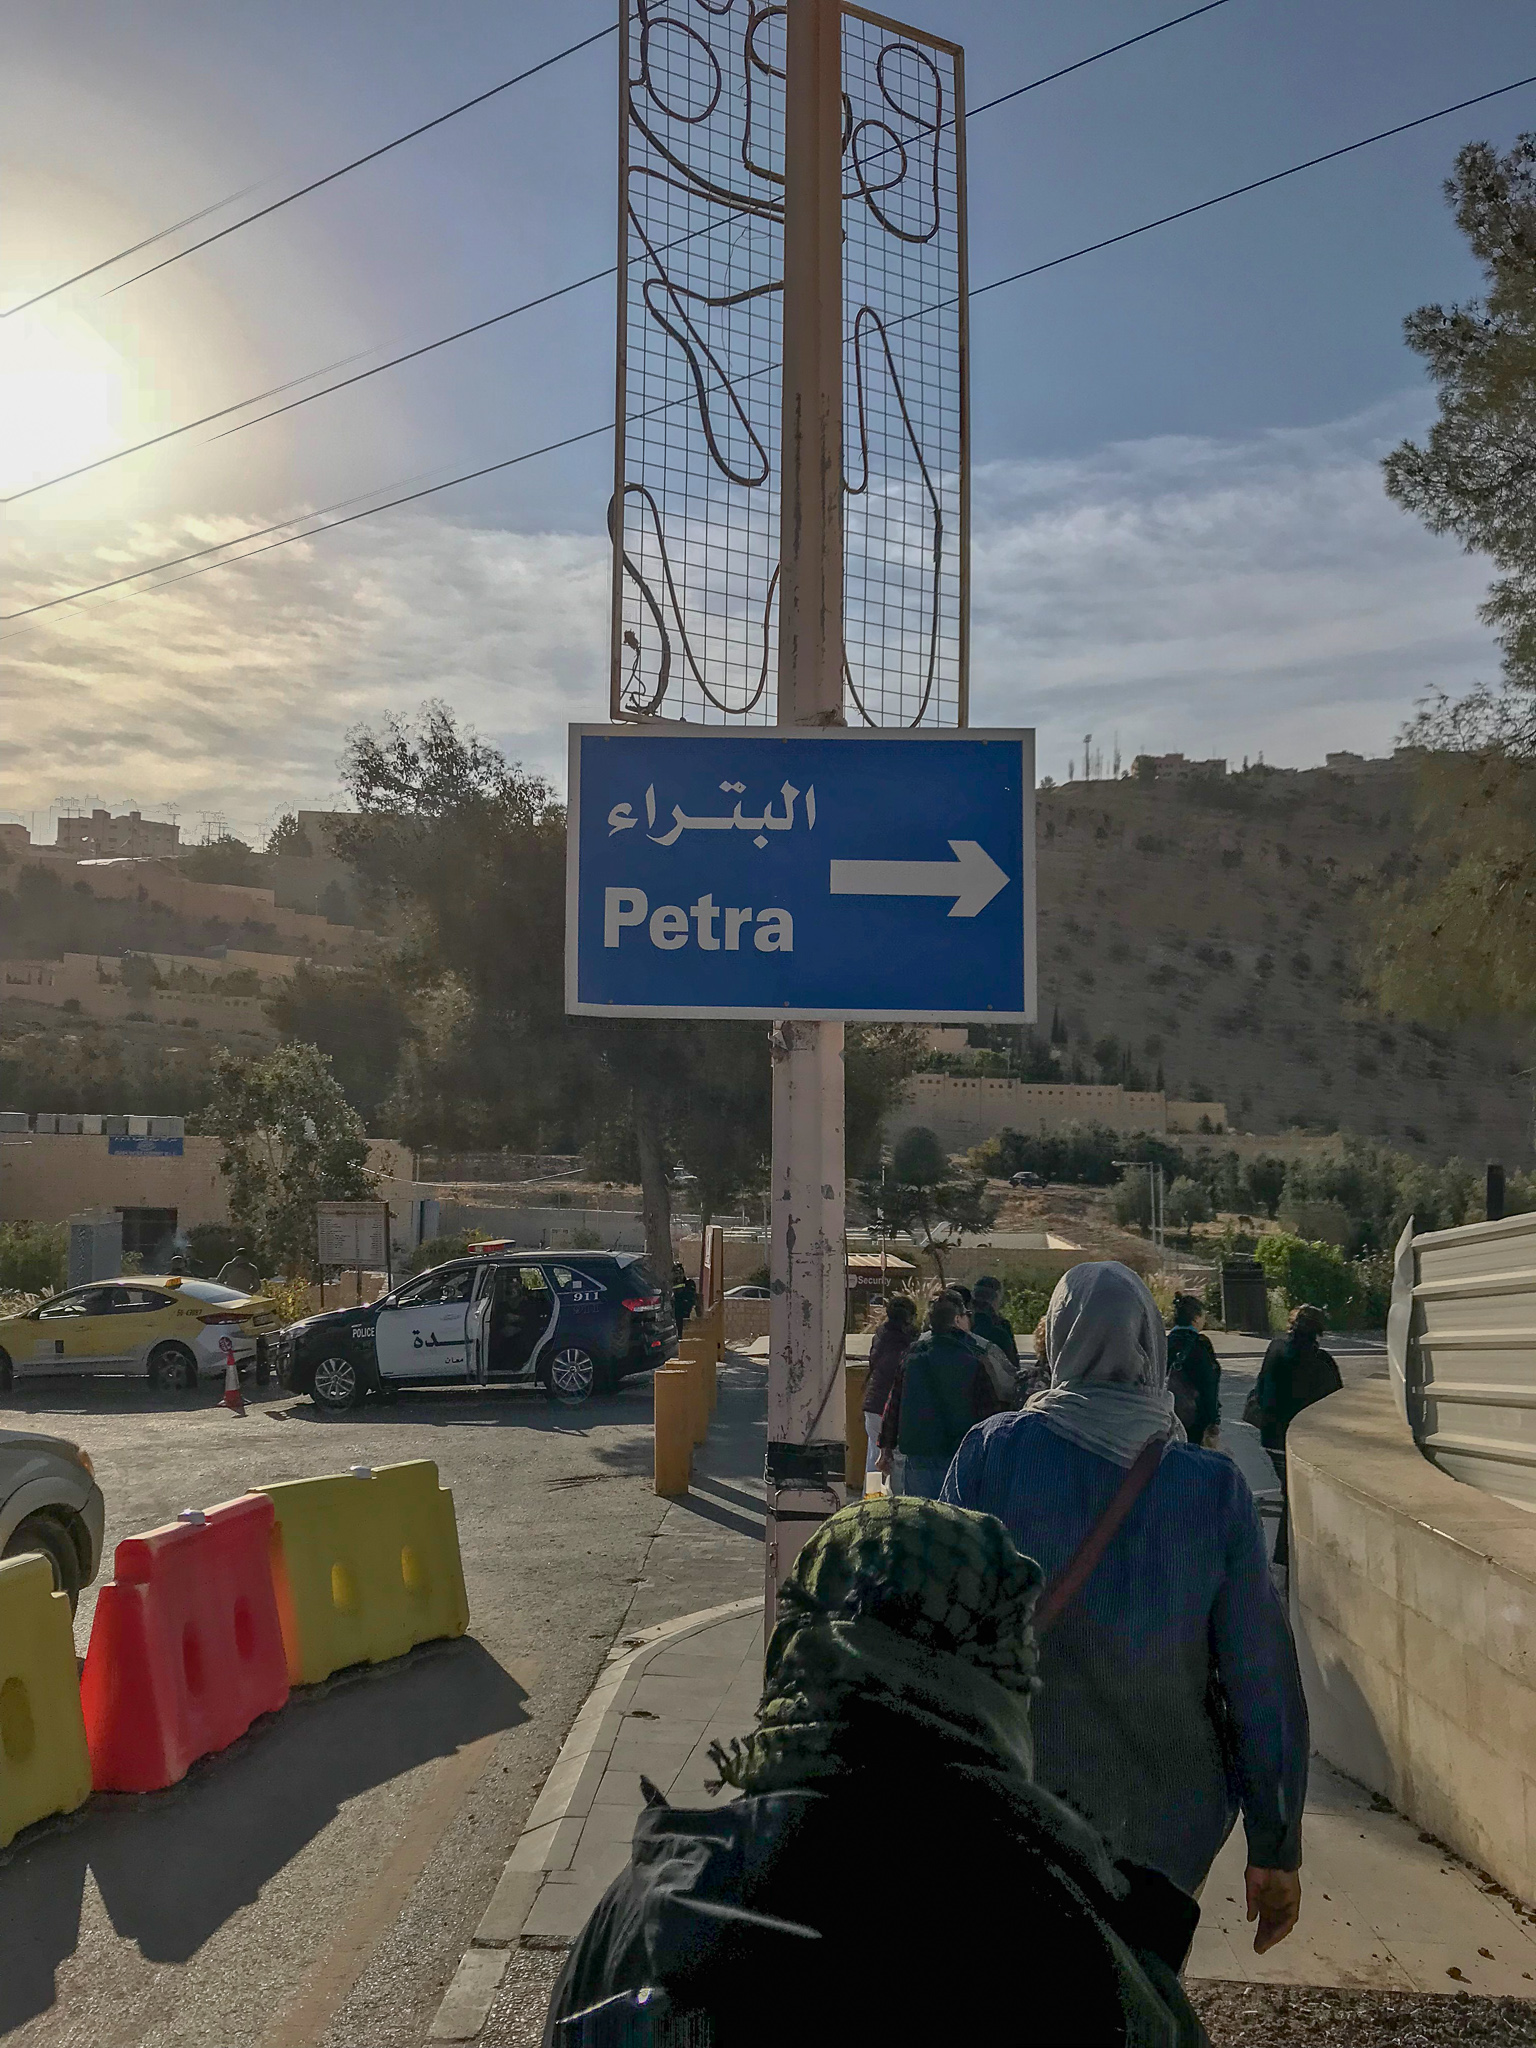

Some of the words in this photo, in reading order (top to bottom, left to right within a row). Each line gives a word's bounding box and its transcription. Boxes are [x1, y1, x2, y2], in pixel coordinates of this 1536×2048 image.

[608, 779, 816, 849] البتراء
[603, 886, 794, 952] Petra
[573, 1291, 599, 1302] 911
[352, 1327, 375, 1338] POLICE
